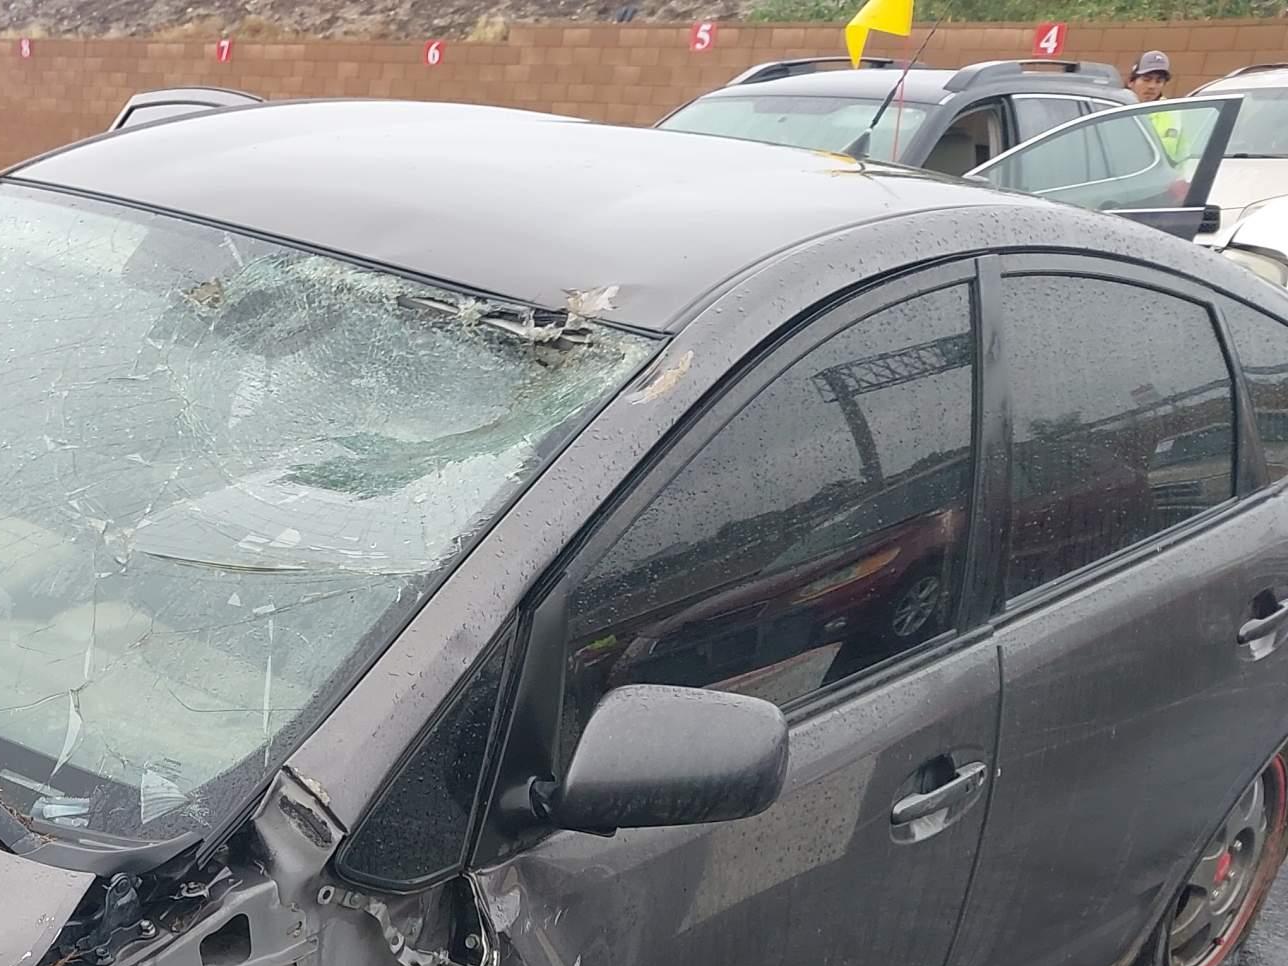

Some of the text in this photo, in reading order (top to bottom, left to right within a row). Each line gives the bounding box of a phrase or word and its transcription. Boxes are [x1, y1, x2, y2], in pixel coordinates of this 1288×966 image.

[21, 38, 31, 58] 8
[695, 23, 713, 49] 5
[1039, 25, 1059, 54] 4
[219, 40, 230, 62] 7
[427, 41, 440, 65] 6
